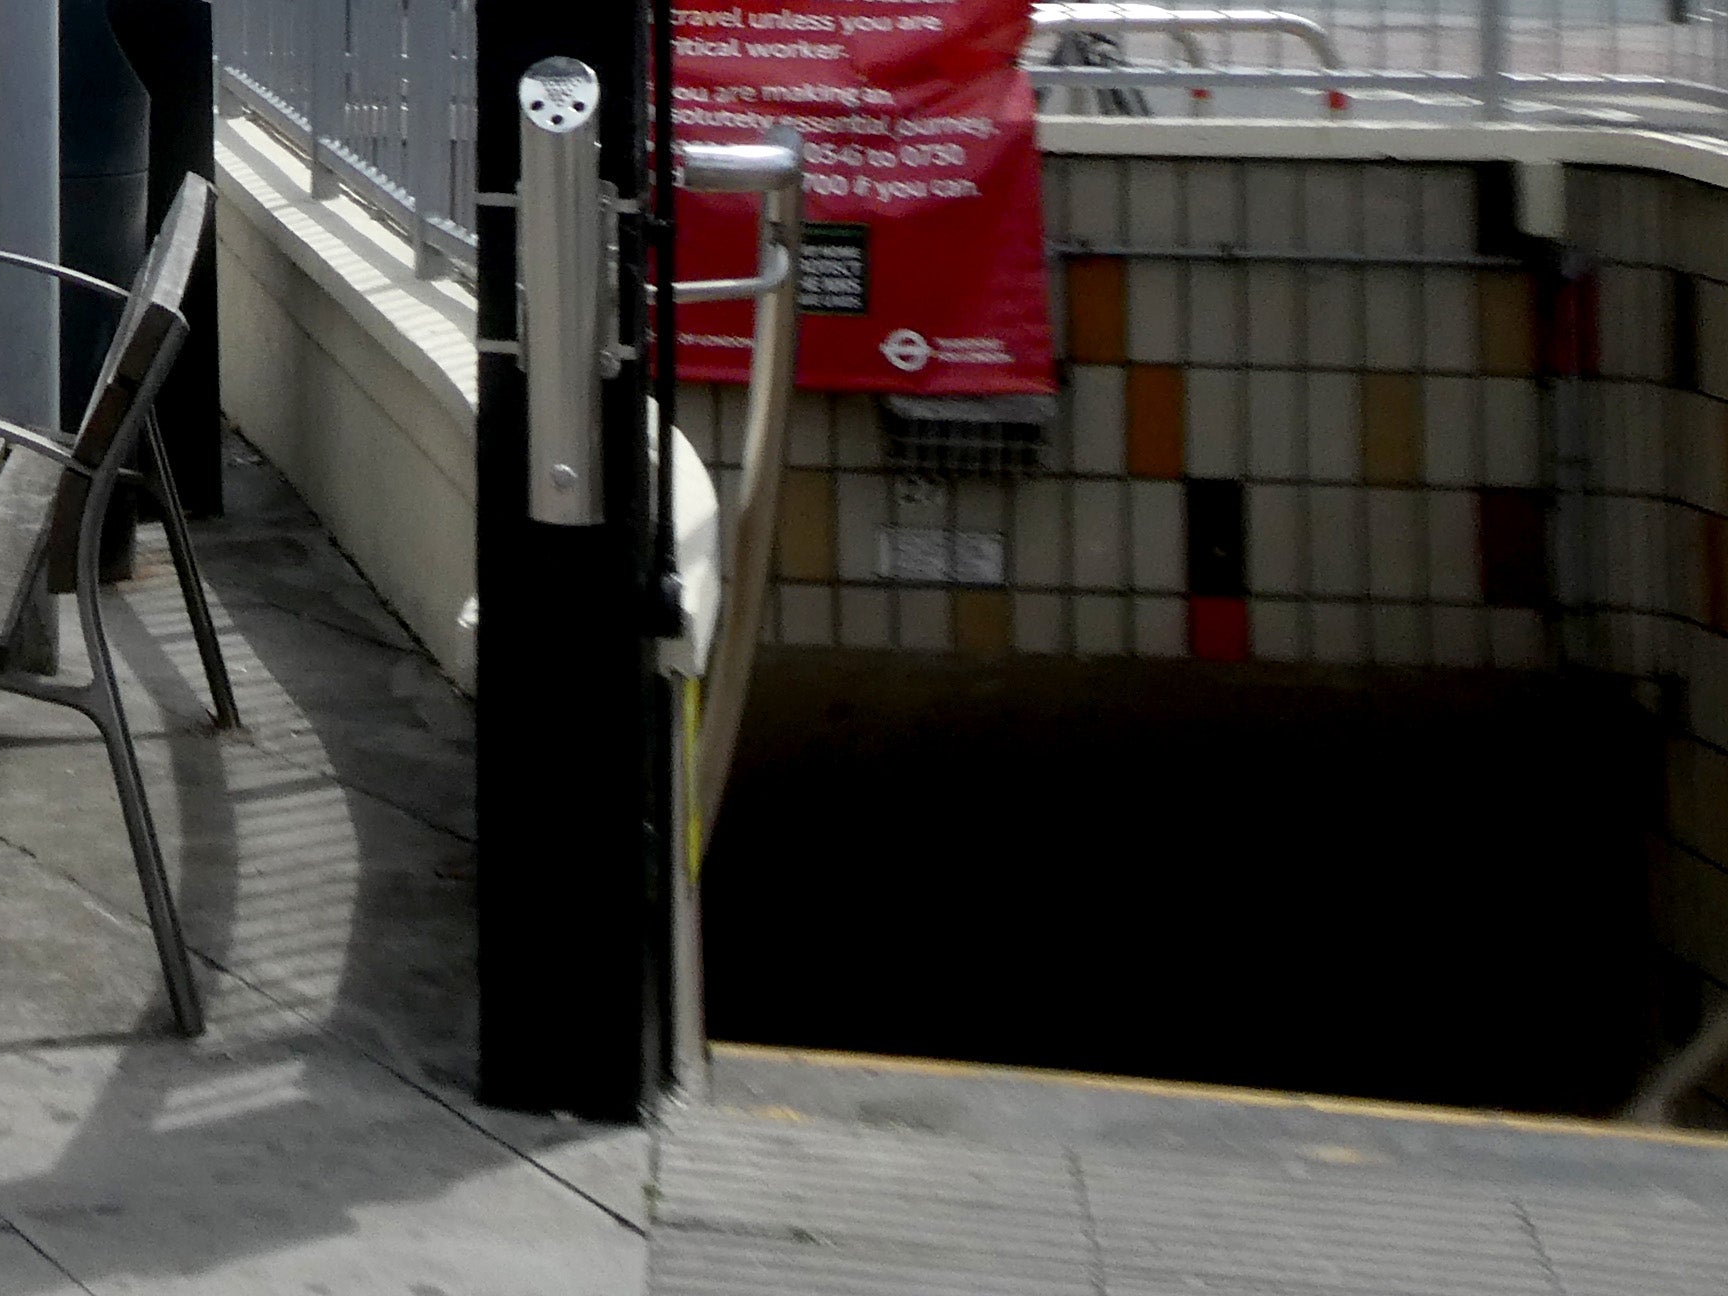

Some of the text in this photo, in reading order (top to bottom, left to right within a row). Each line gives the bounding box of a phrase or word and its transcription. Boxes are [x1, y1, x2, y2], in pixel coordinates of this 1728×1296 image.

[748, 8, 836, 31] unless
[838, 15, 893, 36] you
[896, 15, 943, 31] are
[670, 36, 742, 57] ritical
[672, 87, 709, 102] ou
[714, 86, 759, 103] are
[760, 84, 861, 107] making
[671, 107, 772, 129] solutely
[777, 113, 891, 135] essential
[875, 179, 928, 203] you
